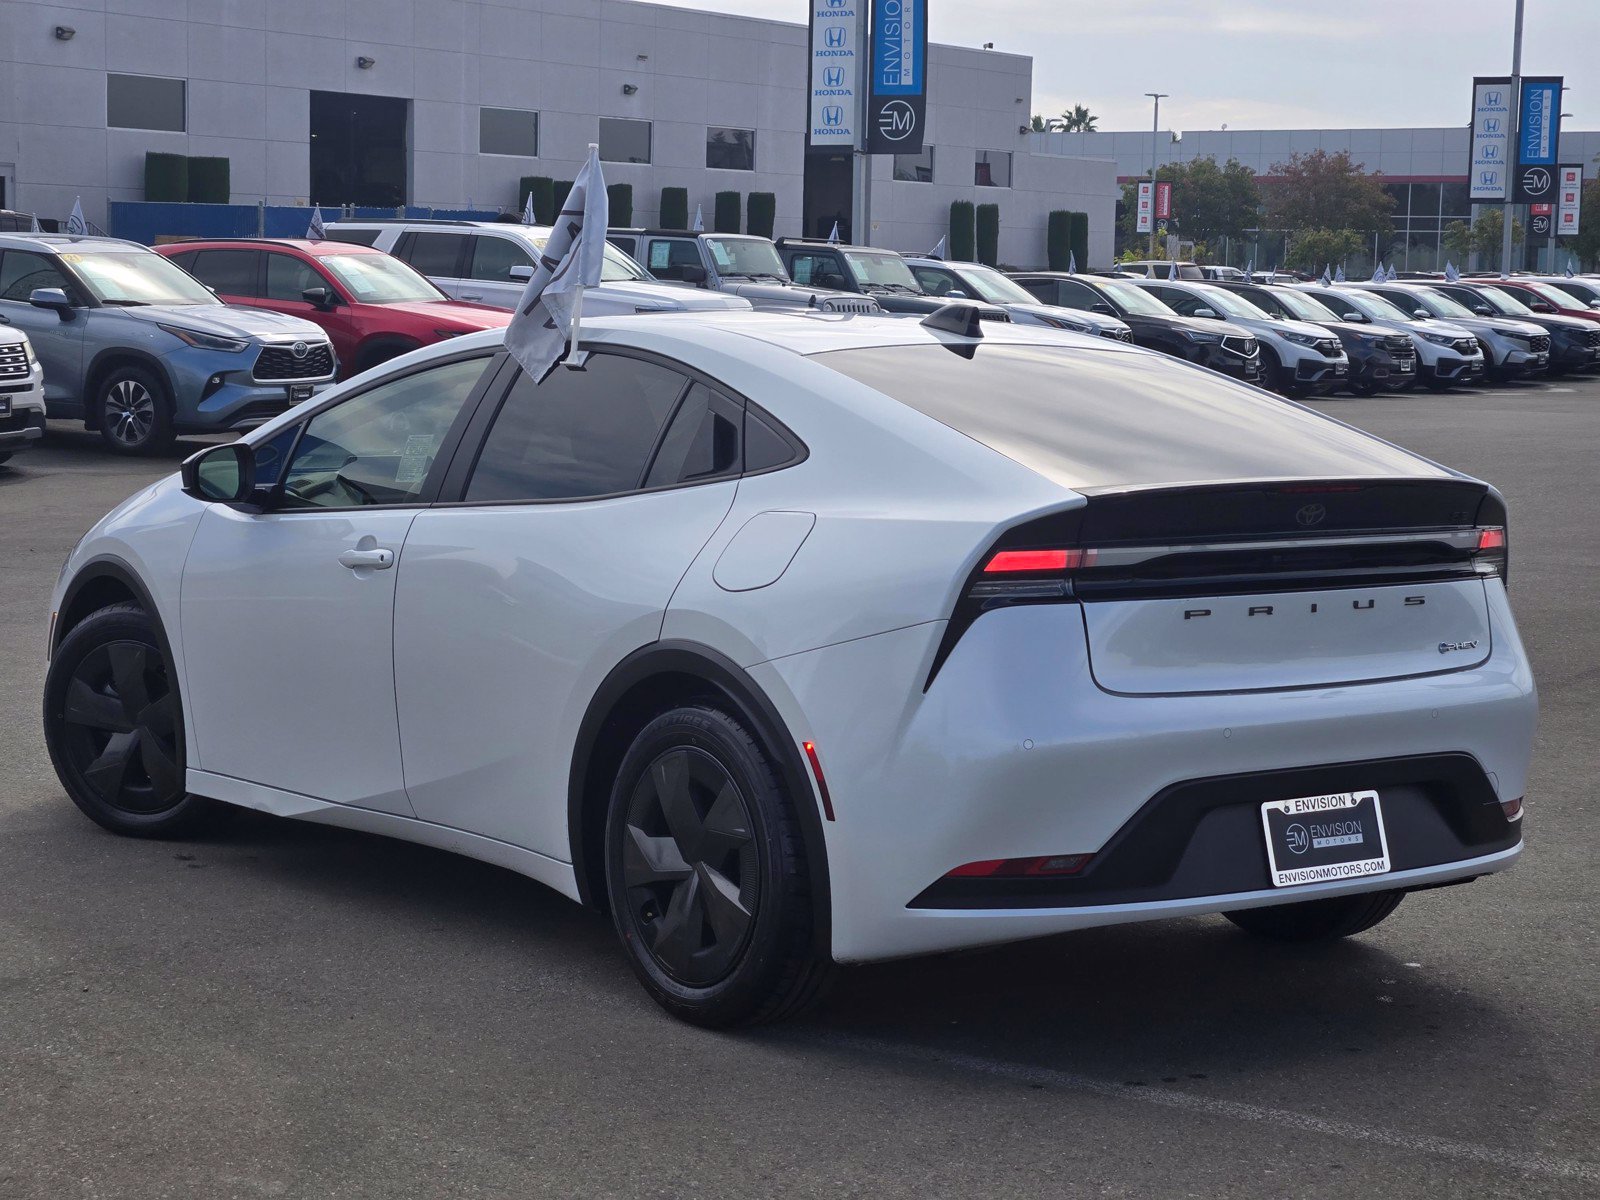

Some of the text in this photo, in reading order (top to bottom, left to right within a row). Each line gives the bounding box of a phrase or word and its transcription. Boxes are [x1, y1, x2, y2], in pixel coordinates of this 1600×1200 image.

[1527, 89, 1542, 158] ENVISION
[1542, 95, 1550, 153] MOTORS
[1184, 595, 1426, 620] PRIUS
[1295, 795, 1346, 812] ENVISION
[1310, 820, 1362, 838] ENVISION
[1317, 836, 1360, 846] MOTORS
[1278, 860, 1385, 884] ENVISIONMOTORS.COM
